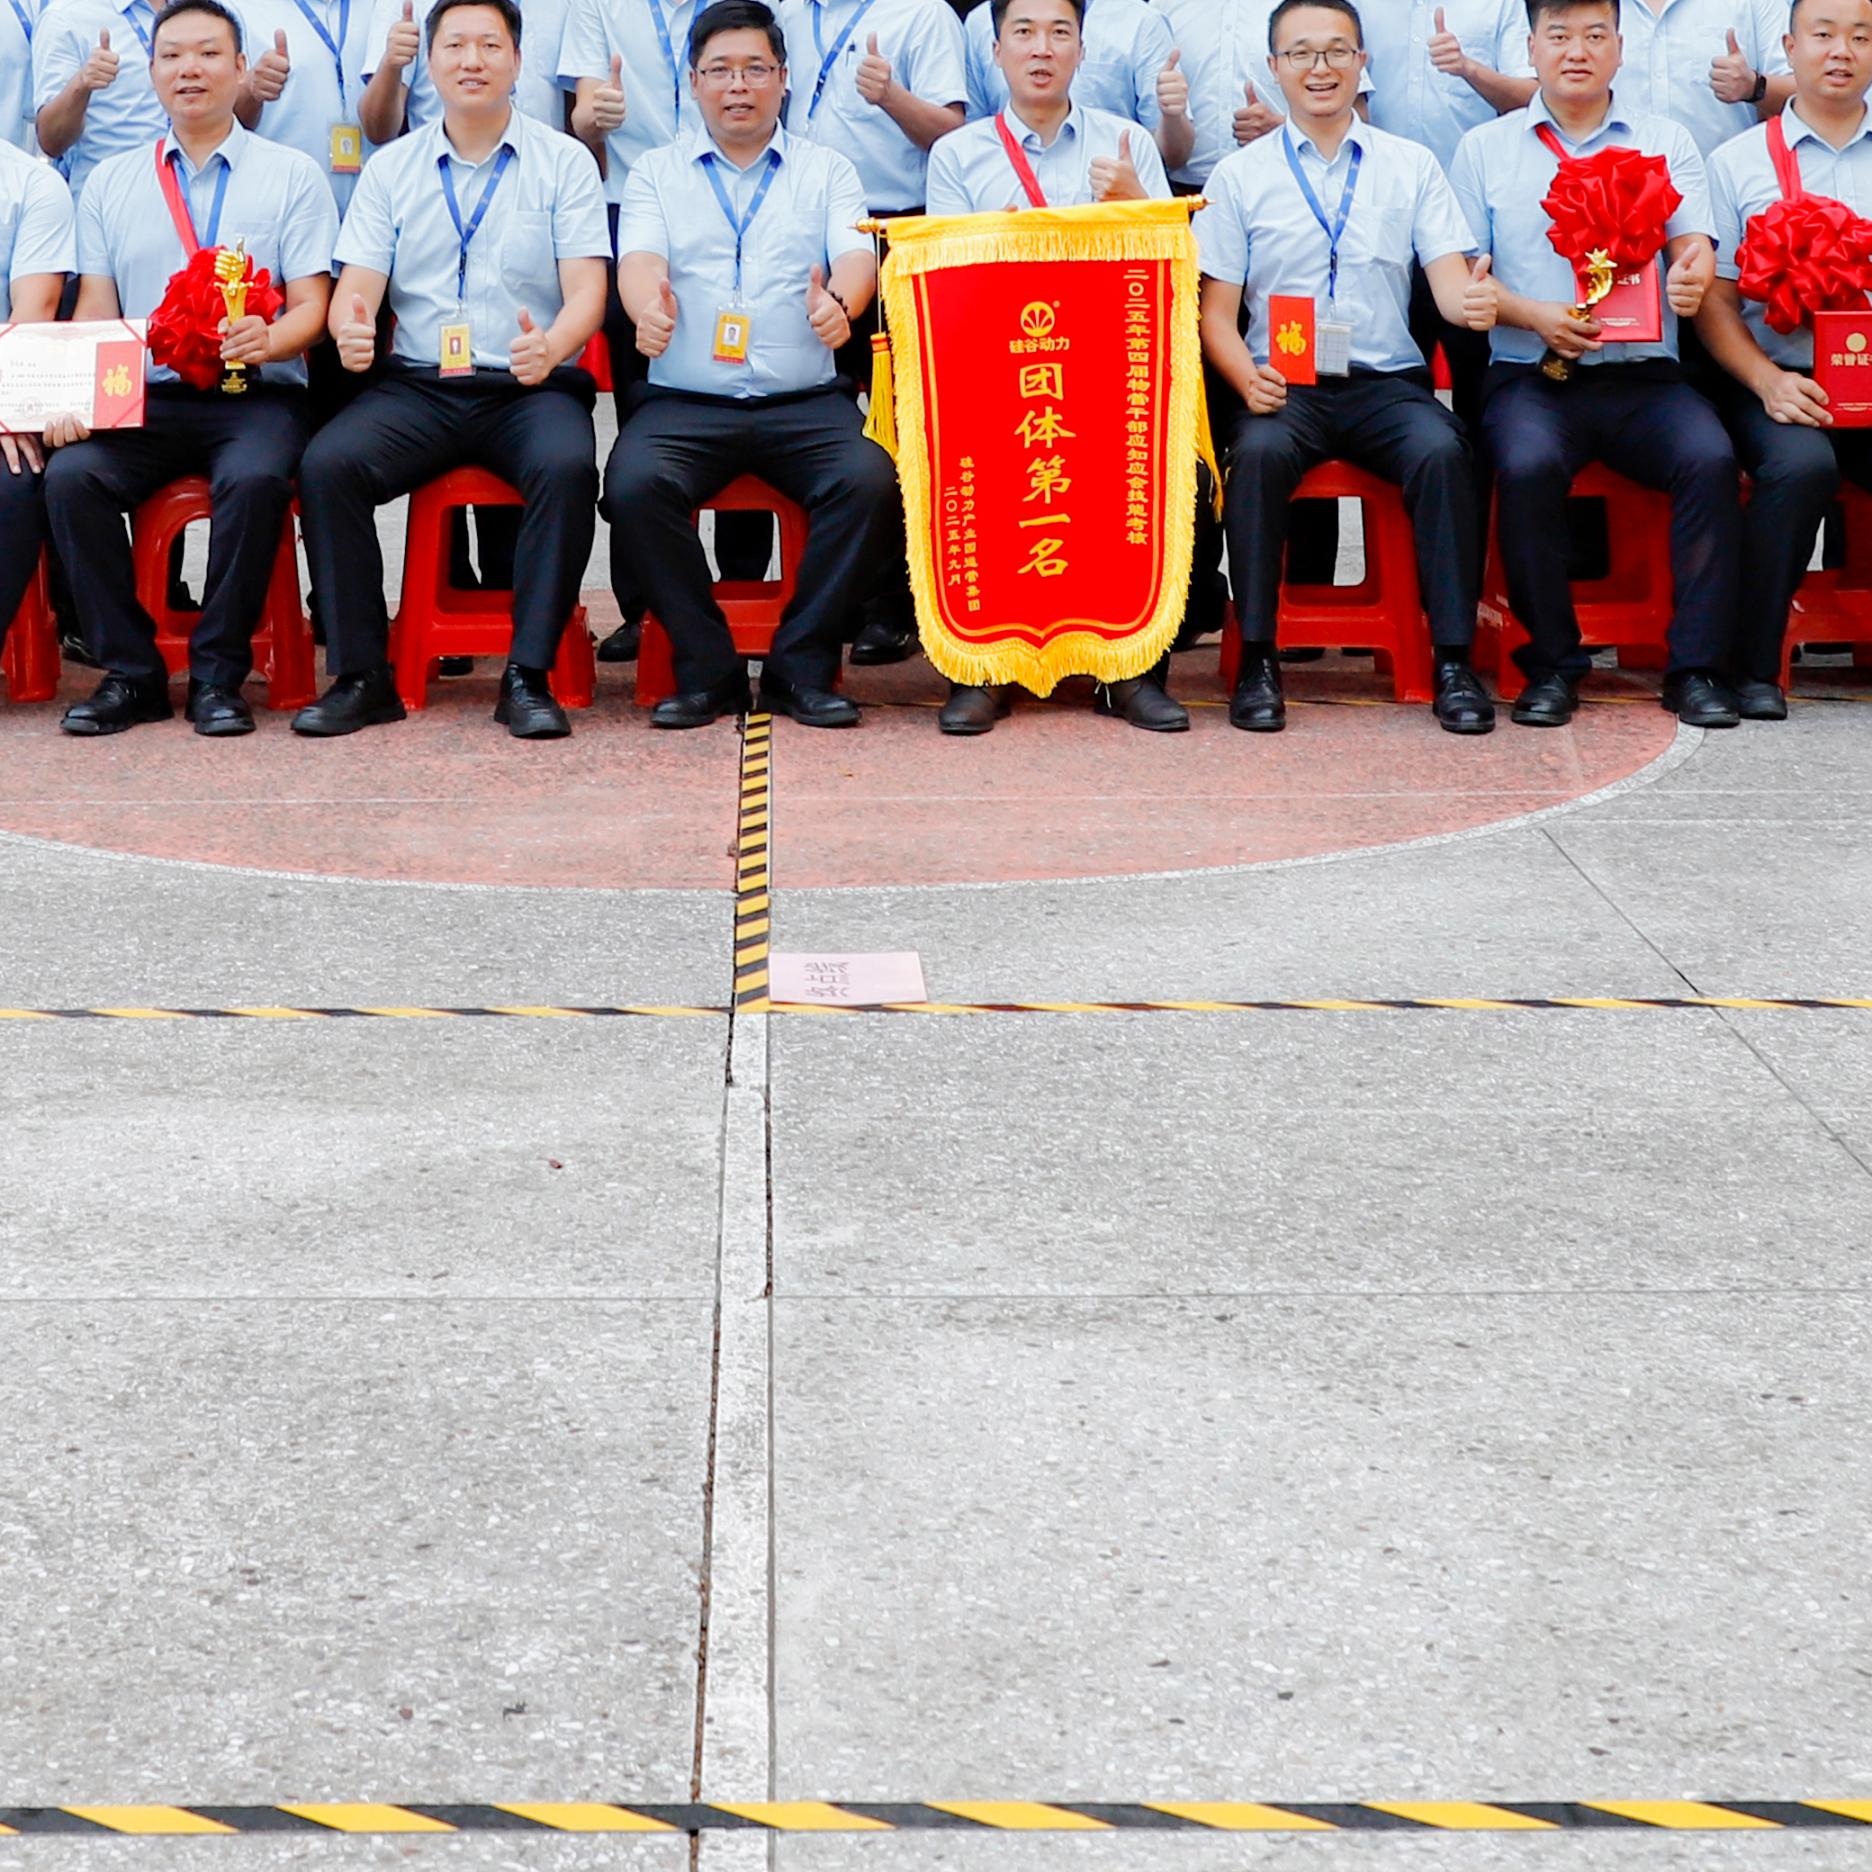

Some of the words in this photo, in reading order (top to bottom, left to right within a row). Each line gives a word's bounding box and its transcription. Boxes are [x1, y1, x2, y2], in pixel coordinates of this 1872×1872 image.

[1009, 335, 1070, 354] 硅谷动力
[1014, 363, 1077, 578] 团体第一名
[943, 486, 962, 587] 二〇二五年九月
